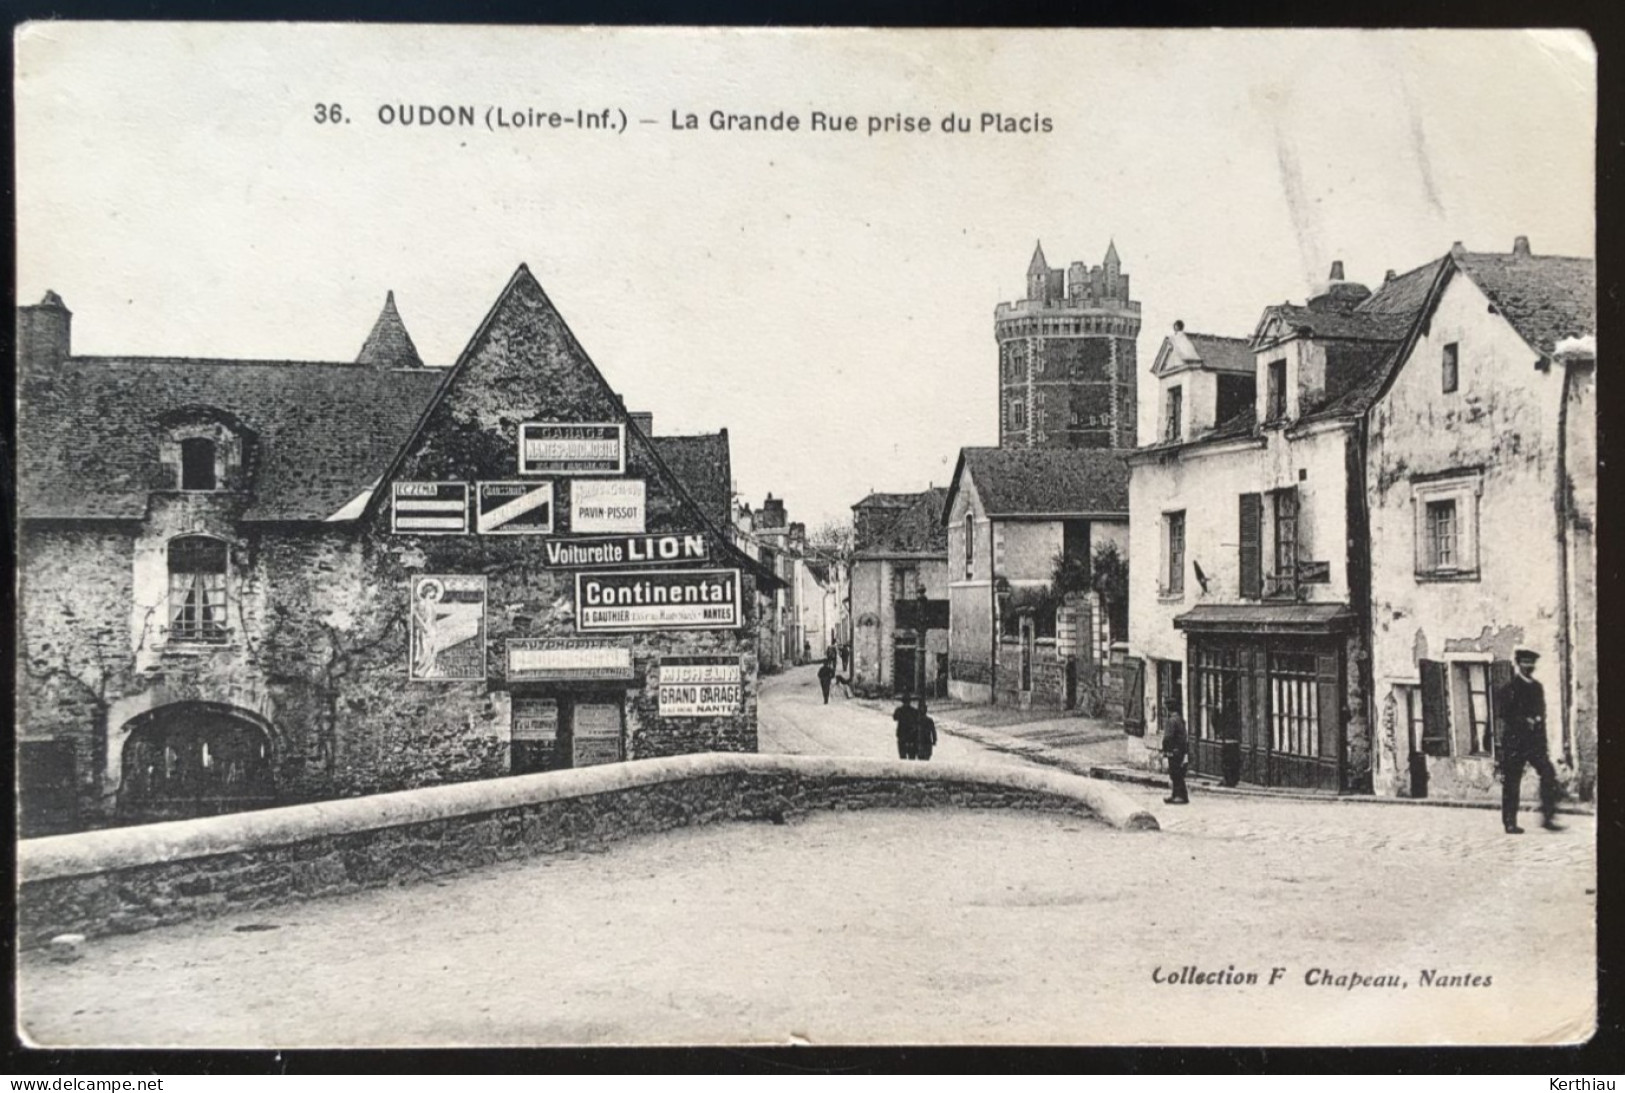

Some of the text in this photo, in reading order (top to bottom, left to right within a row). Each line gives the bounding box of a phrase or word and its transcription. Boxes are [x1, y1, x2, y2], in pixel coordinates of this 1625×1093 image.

[541, 427, 605, 440] GARAGE
[546, 535, 704, 565] Voiturette LION
[586, 579, 732, 605] Continental
[592, 610, 629, 622] GAUTHIER
[662, 666, 739, 682] MICHELIN
[661, 686, 741, 704] GRAND GARAGE
